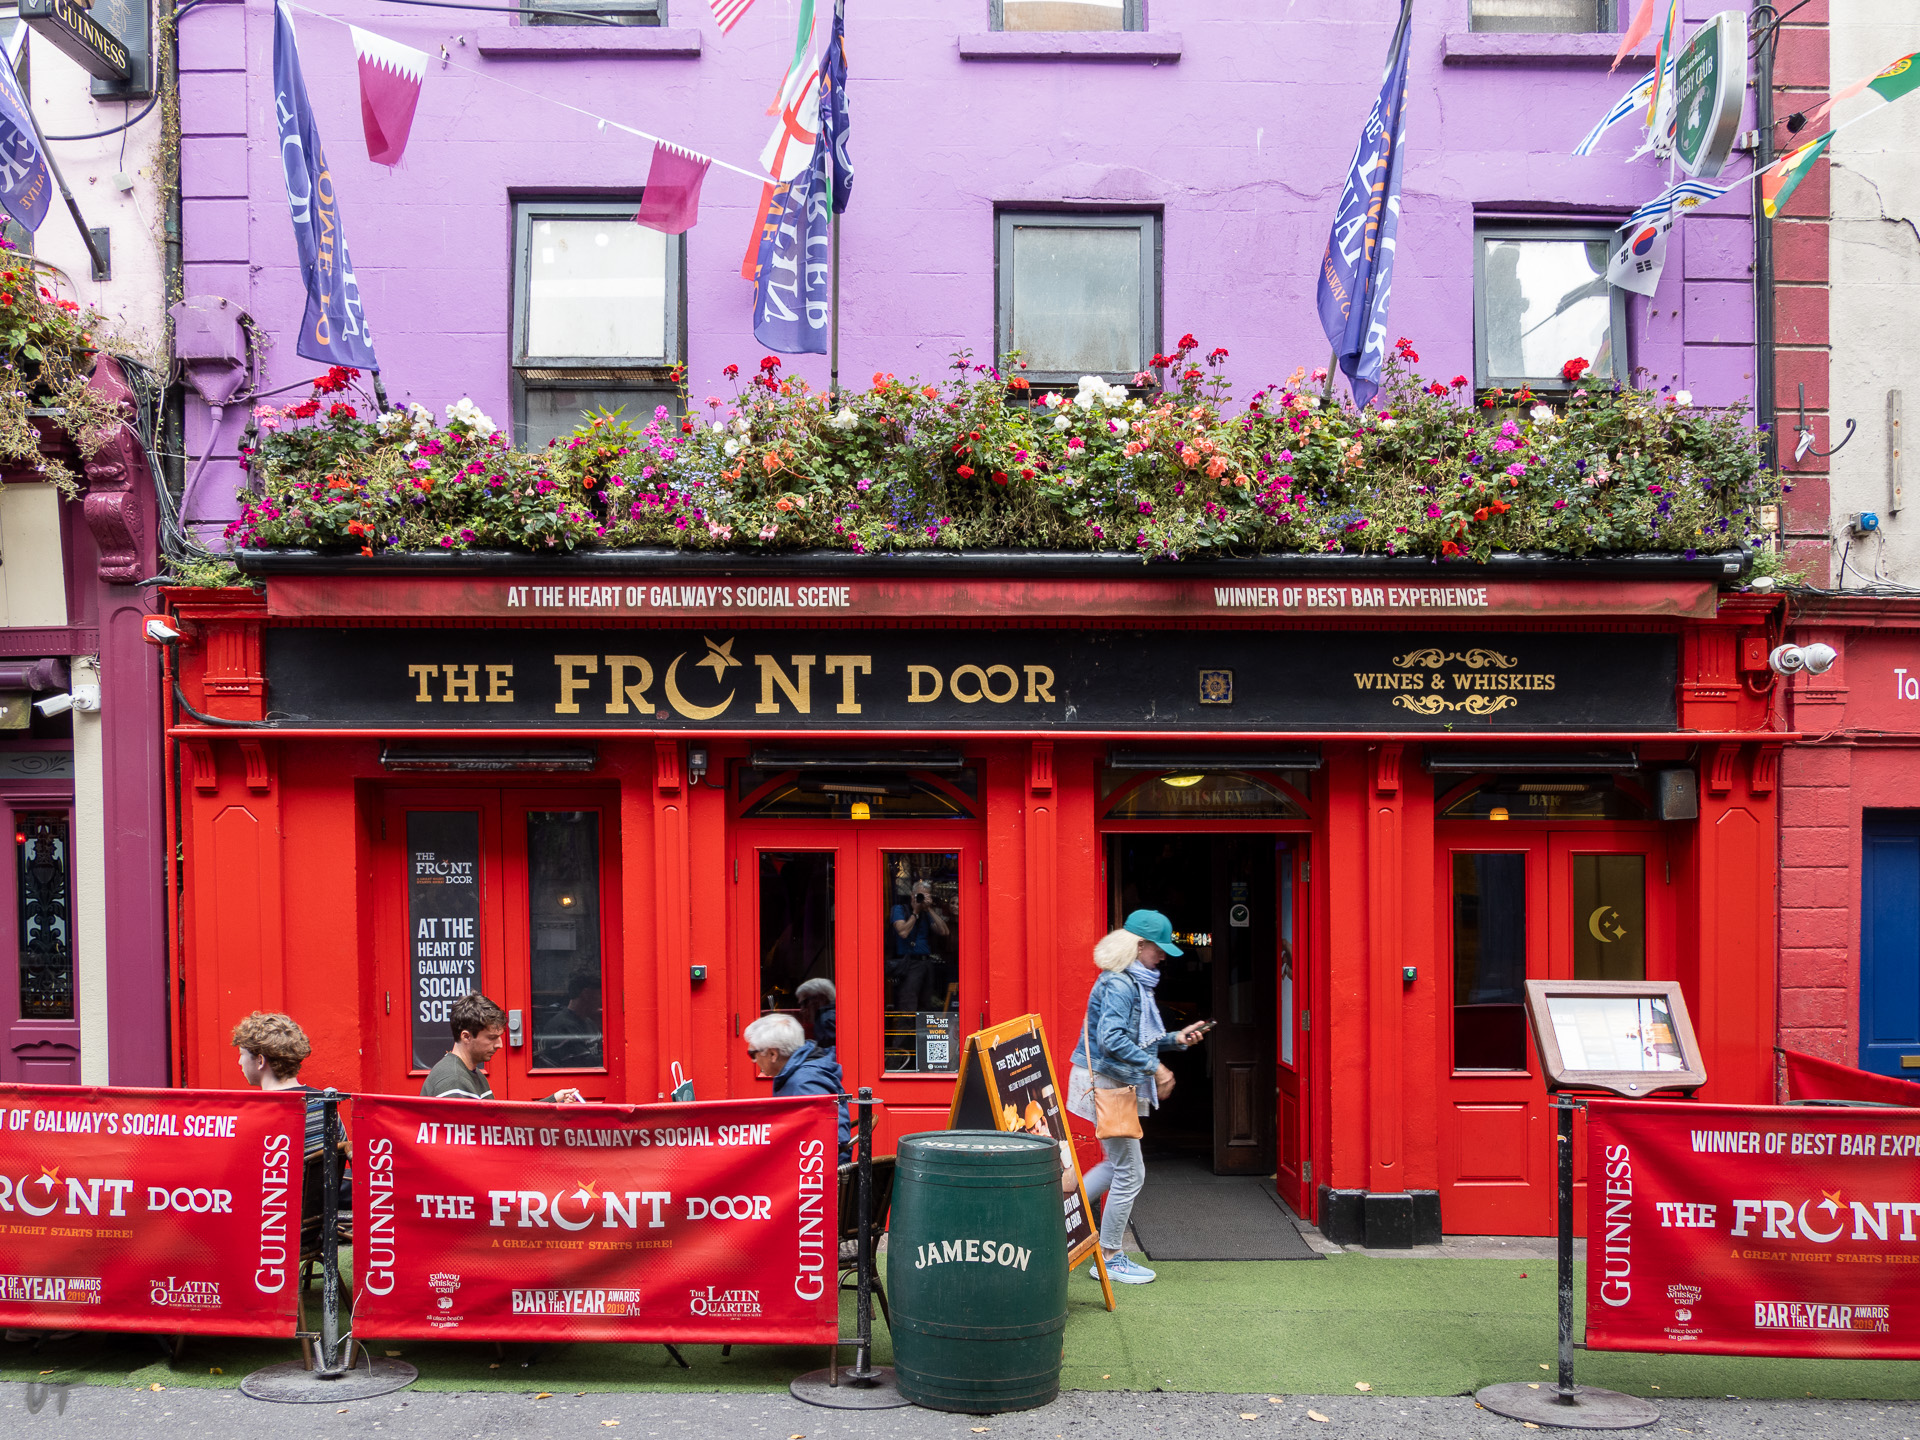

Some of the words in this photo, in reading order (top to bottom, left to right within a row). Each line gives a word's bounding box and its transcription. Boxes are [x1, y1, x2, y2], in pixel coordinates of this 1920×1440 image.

[55, 0, 126, 70] GUINNESS
[1675, 72, 1695, 105] RUGBY
[1695, 56, 1714, 85] CLUB
[507, 586, 526, 608] AT
[533, 586, 565, 608] THE
[569, 586, 621, 608] HEART
[626, 586, 647, 608] OF
[650, 586, 733, 608] GALWAY'S
[736, 586, 794, 608] SOCIAL
[798, 586, 850, 608] SCENE
[1214, 586, 1280, 608] WINNER
[1284, 586, 1303, 608] OF
[1306, 586, 1348, 608] BEST
[1351, 586, 1386, 608] BAR
[1389, 586, 1489, 608] EXPERIENCE
[408, 664, 515, 703] THE
[907, 663, 1057, 704] DOOR
[1354, 672, 1425, 691] WINES
[1430, 672, 1446, 691] &
[1452, 672, 1556, 692] WHISKIES
[1166, 790, 1245, 806] WHISKEY
[1528, 794, 1561, 807] BAR
[415, 852, 435, 861] THE
[445, 875, 473, 884] DOOR
[417, 918, 438, 939] AT
[442, 918, 474, 939] THE
[418, 942, 456, 957] HEART
[459, 942, 475, 957] OF
[418, 960, 475, 975] GALWAY'S
[419, 1000, 456, 1023] SCE
[8, 1108, 30, 1131] OF
[34, 1110, 119, 1135] GALWAY'S
[122, 1113, 180, 1137] SOCIAL
[183, 1115, 238, 1138] SCENE
[416, 1123, 440, 1145] AT
[443, 1123, 477, 1146] THE
[480, 1125, 536, 1146] HEART
[539, 1127, 561, 1147] OF
[564, 1128, 650, 1147] GALWAY'S
[654, 1126, 713, 1147] SOCIAL
[717, 1123, 771, 1146] SCENE
[1691, 1130, 1760, 1153] WINNER
[1764, 1132, 1787, 1154] OF
[1791, 1133, 1837, 1155] BEST
[1840, 1135, 1876, 1156] BAR
[919, 1140, 1039, 1150] JAMESON
[0, 1165, 134, 1217] RONT
[147, 1186, 233, 1214] DOOR
[254, 1134, 291, 1294] GUINNESS
[416, 1194, 475, 1219] THE
[685, 1195, 772, 1220] DOOR
[1656, 1201, 1717, 1228] THE
[365, 1138, 396, 1296] GUINNESS
[795, 1139, 825, 1301] GUINNESS
[1600, 1144, 1633, 1307] GUINNESS
[9, 1226, 47, 1236] NIGHT
[50, 1227, 93, 1238] STARTS
[95, 1229, 133, 1239] HERE!
[491, 1239, 500, 1248] A
[502, 1239, 543, 1249] GREAT
[546, 1240, 585, 1249] NIGHT
[588, 1240, 633, 1250] STARTS
[635, 1239, 673, 1249] HERE!
[914, 1239, 1032, 1272] JAMESON
[1731, 1250, 1740, 1259] A
[1742, 1251, 1787, 1261] GREAT
[1791, 1252, 1832, 1262] NIGHT
[1836, 1253, 1883, 1263] STARTS
[8, 1276, 20, 1288] OF
[24, 1277, 66, 1301] YEAR
[68, 1278, 102, 1291] AWARDS
[167, 1276, 220, 1294] LATIN
[8, 1288, 25, 1299] THE
[67, 1290, 87, 1301] 2019
[150, 1288, 223, 1307] QUARTER
[512, 1291, 546, 1313] BAR
[548, 1290, 559, 1301] OF
[562, 1290, 605, 1314] YEAR
[607, 1290, 640, 1302] AWARDS
[706, 1285, 760, 1302] LATIN
[548, 1301, 565, 1312] THE
[606, 1303, 625, 1314] 2019
[690, 1297, 763, 1316] QUARTER
[1755, 1303, 1789, 1327] BAR
[1790, 1304, 1802, 1315] OF
[1854, 1306, 1889, 1319] AWARDS
[1791, 1315, 1808, 1327] THE
[1805, 1304, 1852, 1329] YEAR
[1853, 1319, 1874, 1330] 2019
